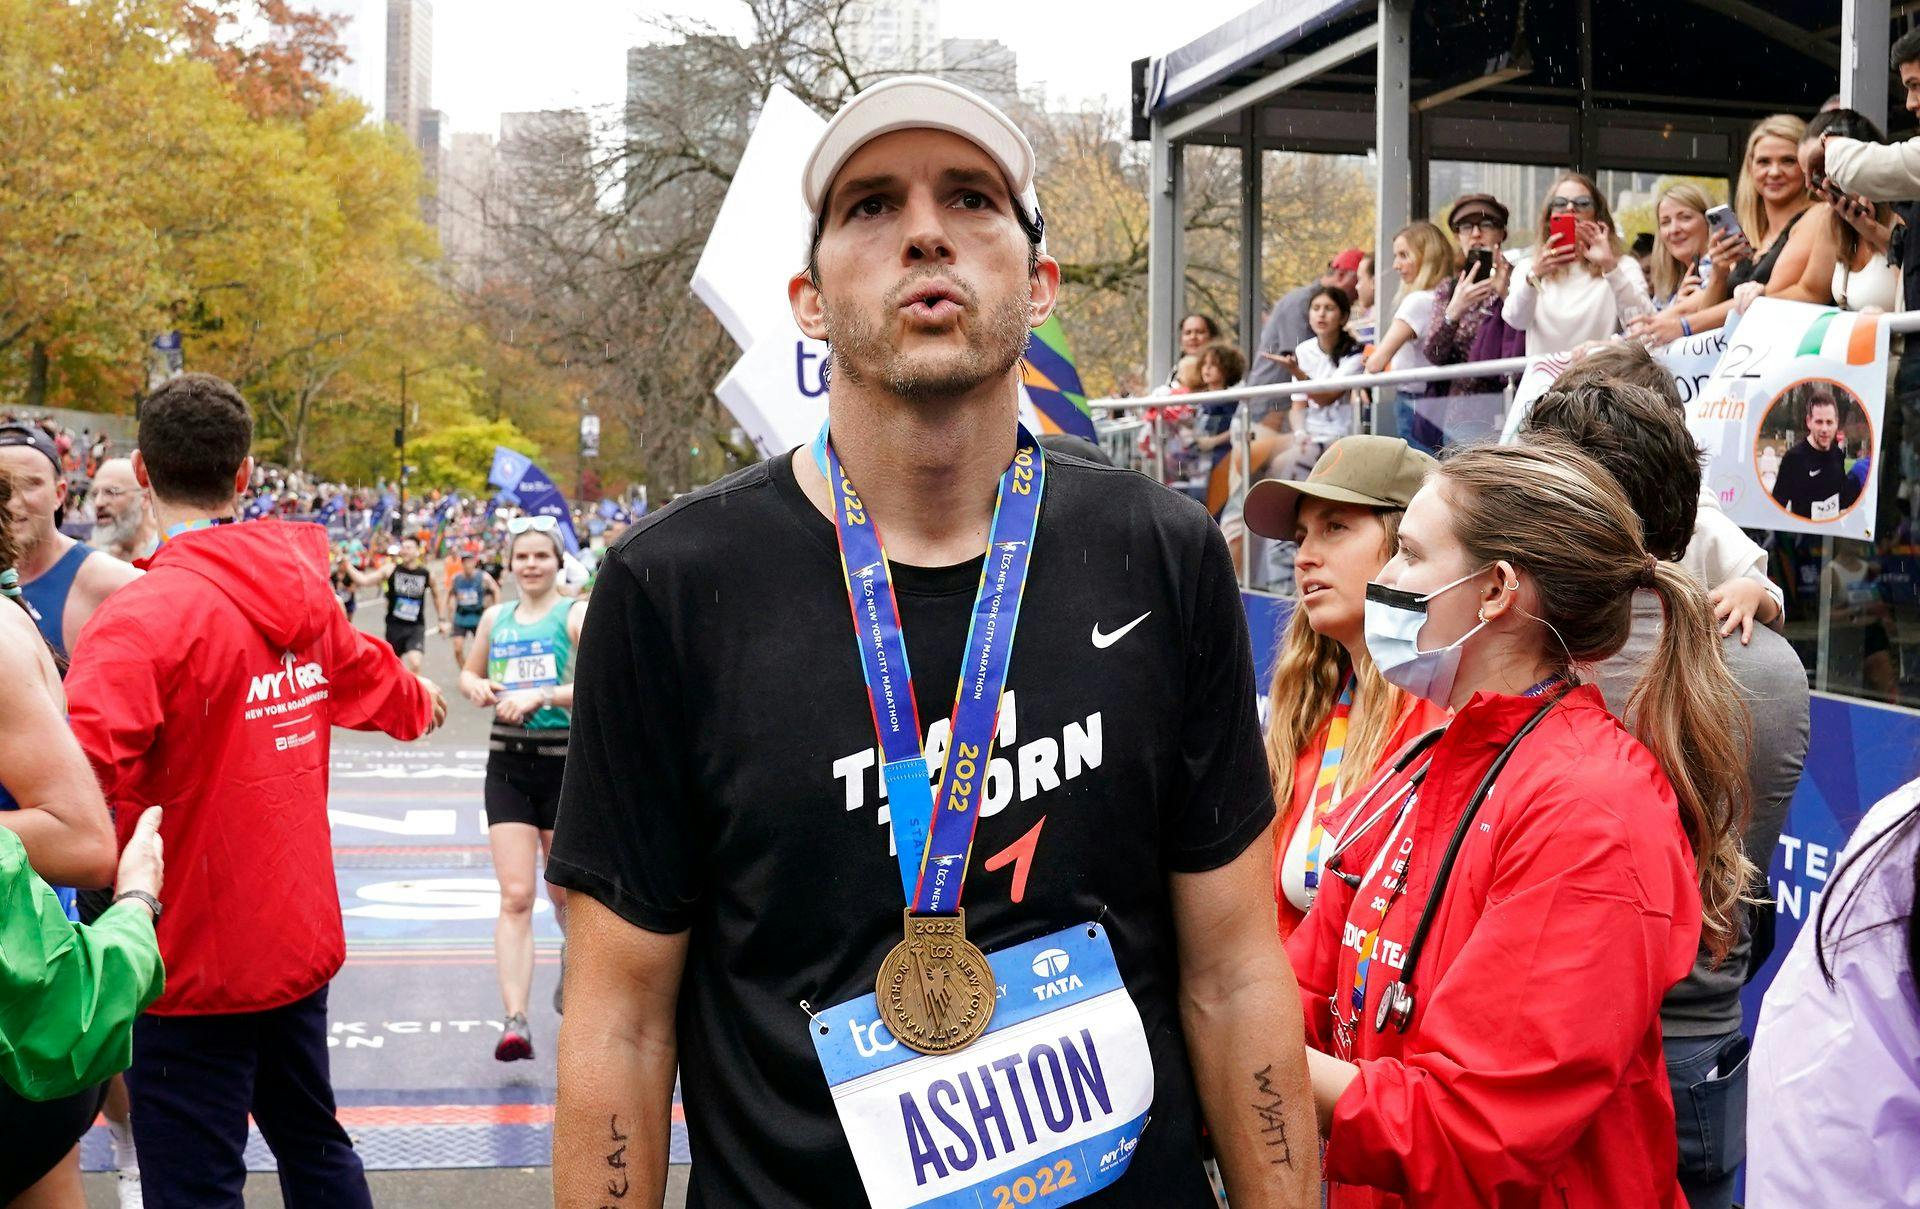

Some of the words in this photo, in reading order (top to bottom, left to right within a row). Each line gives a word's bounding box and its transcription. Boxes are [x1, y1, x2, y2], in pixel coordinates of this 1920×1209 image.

[1001, 553, 1013, 570] tcs
[863, 579, 875, 597] tcs
[997, 571, 1006, 593] NEW
[866, 598, 878, 621] NEW
[989, 594, 1002, 619] YORK
[871, 622, 884, 650] YORK
[987, 620, 997, 645] CITY
[877, 651, 889, 675] CITY
[974, 644, 992, 701] MARATHON
[244, 707, 264, 721] NEW
[264, 702, 288, 716] YORK
[882, 675, 900, 733] MARATHON
[833, 690, 1017, 812] TA
[947, 741, 980, 813] 2022
[1778, 833, 1842, 882] TE
[935, 868, 950, 887] tcs
[929, 887, 942, 912] NEW
[916, 922, 955, 935] 2022
[930, 943, 954, 959] tcs
[957, 958, 980, 988] NEW
[890, 963, 926, 1037] MARATHON
[1032, 974, 1084, 1002] TATA
[960, 990, 981, 1027] YORK
[928, 1025, 960, 1041] CITY
[898, 1028, 1114, 1187] ASHTON
[1251, 1064, 1295, 1172] WYATT
[991, 1158, 1078, 1209] 2022
